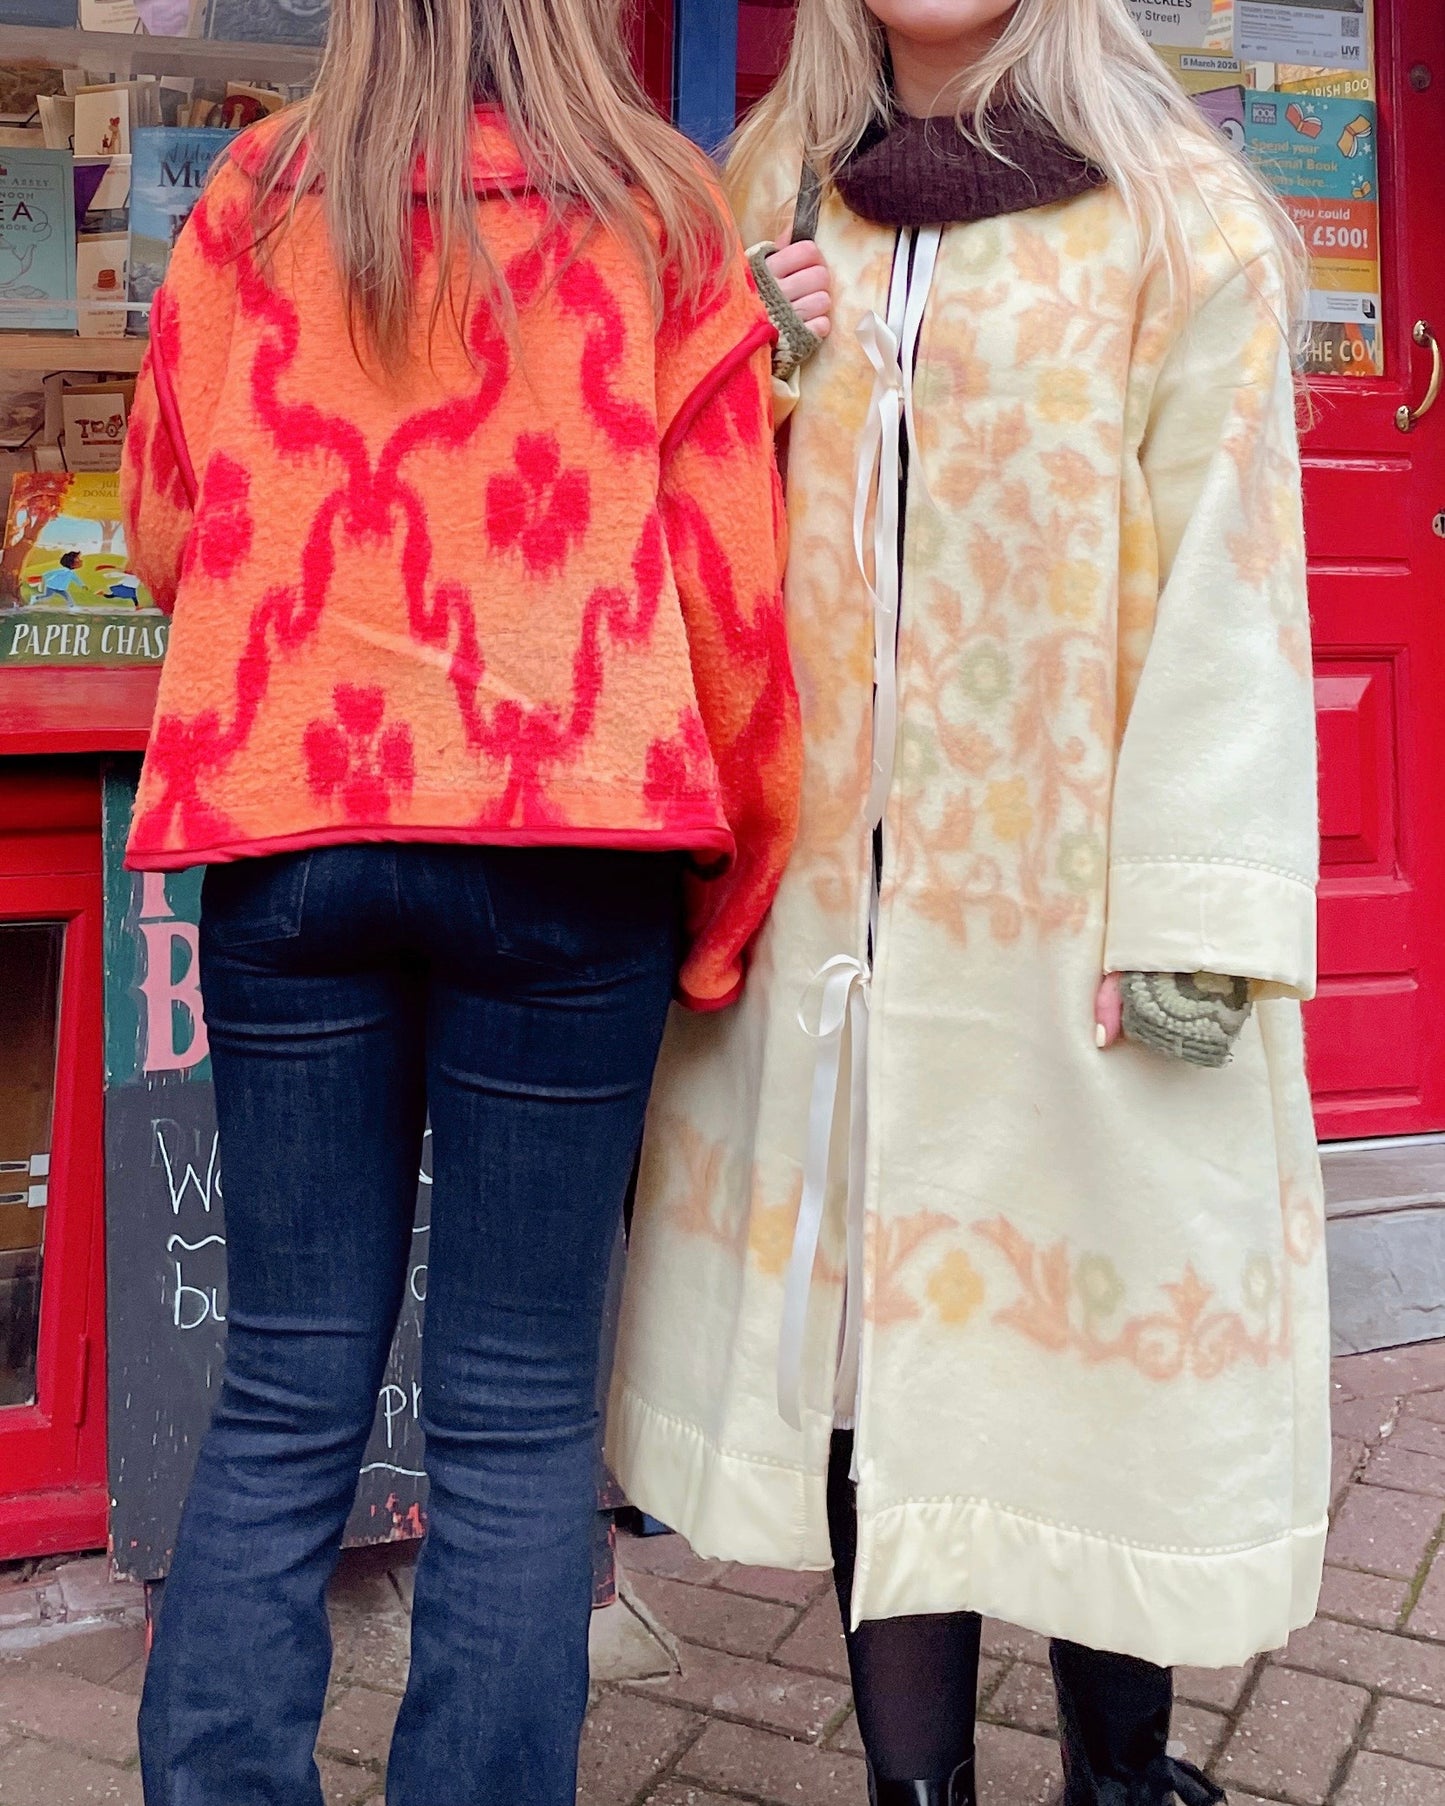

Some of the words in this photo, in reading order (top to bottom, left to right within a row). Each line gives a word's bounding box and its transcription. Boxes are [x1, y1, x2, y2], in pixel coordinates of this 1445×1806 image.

[1145, 9, 1181, 24] Street)
[1190, 59, 1216, 68] March
[1217, 61, 1238, 70] 2026
[1292, 144, 1320, 155] your
[1306, 159, 1338, 173] Book
[1293, 207, 1315, 219] you
[1318, 208, 1351, 220] could
[1312, 226, 1369, 249] £500!
[9, 623, 91, 657] PAPER
[101, 624, 170, 659] CHAS
